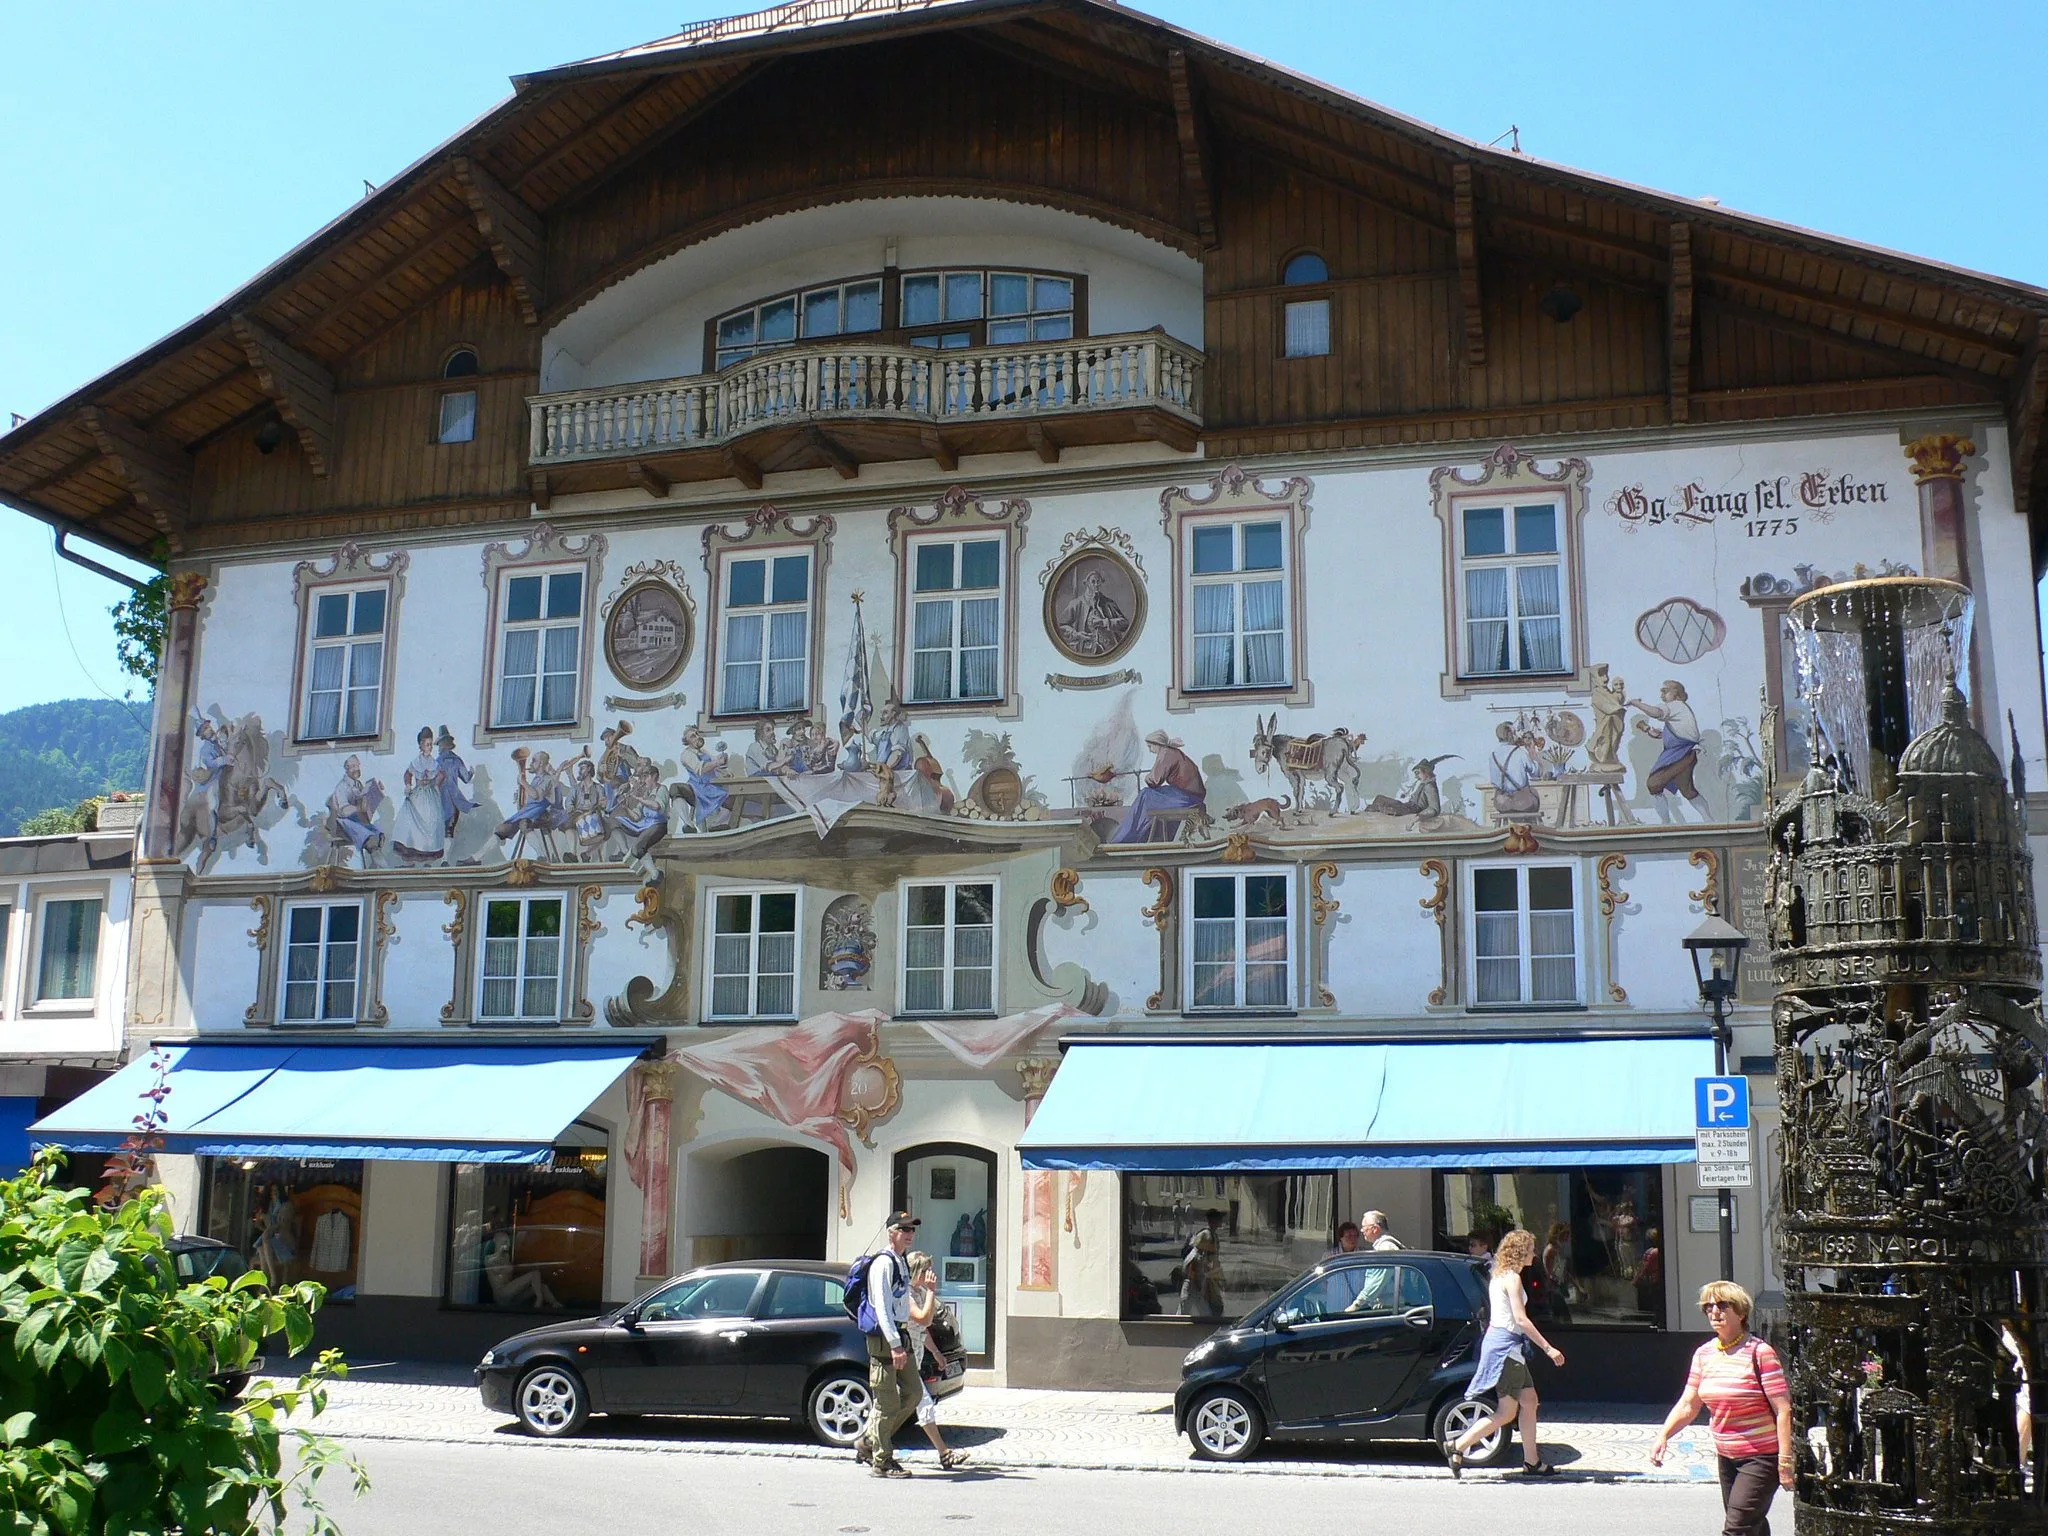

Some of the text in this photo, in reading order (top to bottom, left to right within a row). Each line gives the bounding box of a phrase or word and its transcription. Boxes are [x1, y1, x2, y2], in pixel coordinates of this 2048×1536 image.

[1672, 480, 1749, 528] Lang
[1796, 470, 1889, 513] Erben
[1744, 517, 1800, 538] 1775
[850, 1081, 868, 1096] 20
[1707, 1083, 1735, 1122] P
[1713, 1131, 1746, 1139] Parkschein
[1717, 1140, 1722, 1148] 2
[554, 1166, 583, 1174] exklusiv
[1702, 1175, 1734, 1184] Feiertagen
